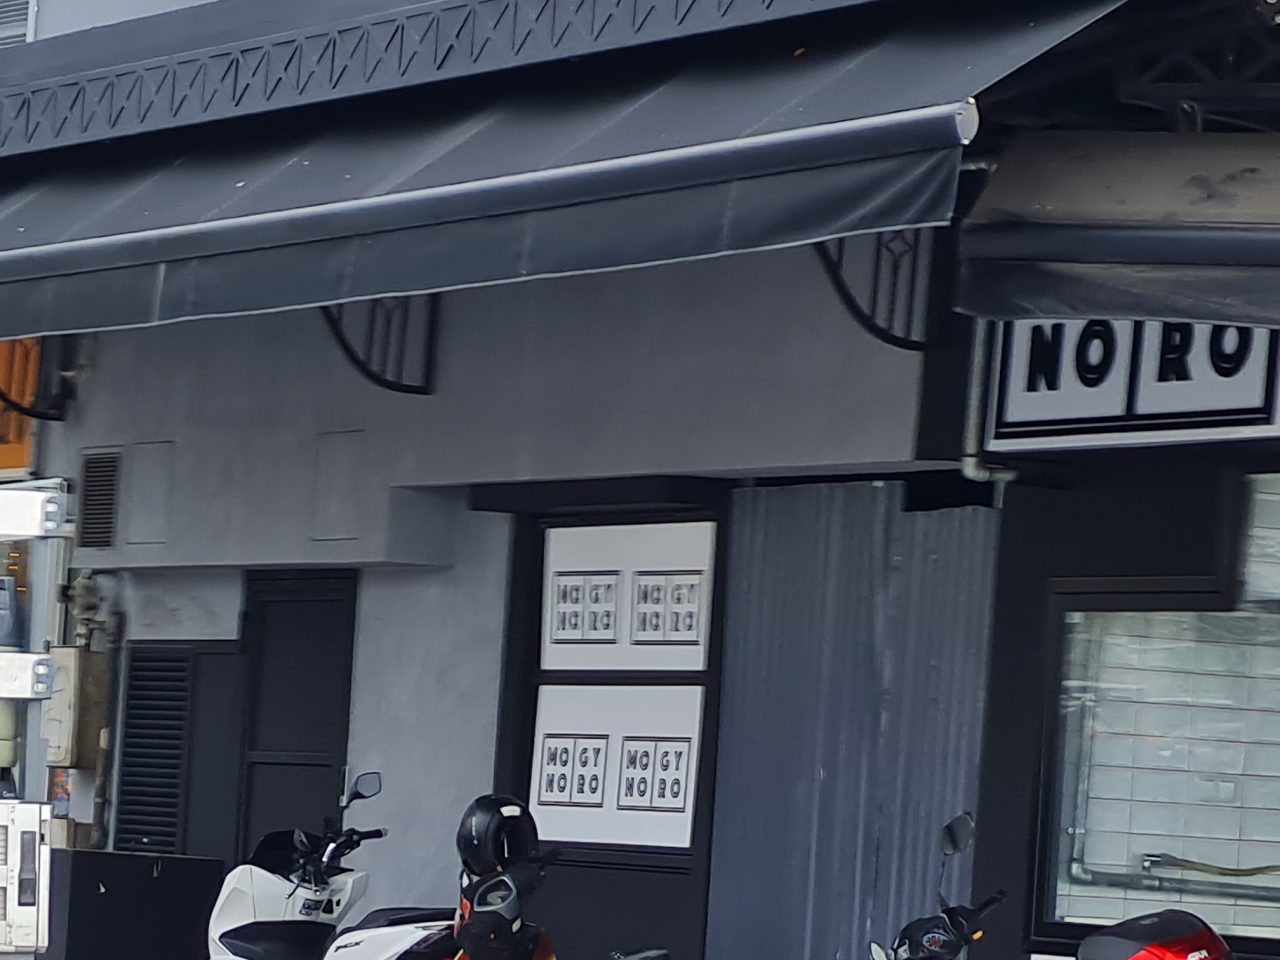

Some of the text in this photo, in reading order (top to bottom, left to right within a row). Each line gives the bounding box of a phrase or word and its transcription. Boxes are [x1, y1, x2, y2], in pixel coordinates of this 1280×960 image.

[1026, 319, 1255, 392] NO RO
[546, 746, 601, 768] MO GY
[626, 749, 683, 771] MO GY
[545, 773, 599, 794] NO RO
[624, 777, 681, 799] NO RO
